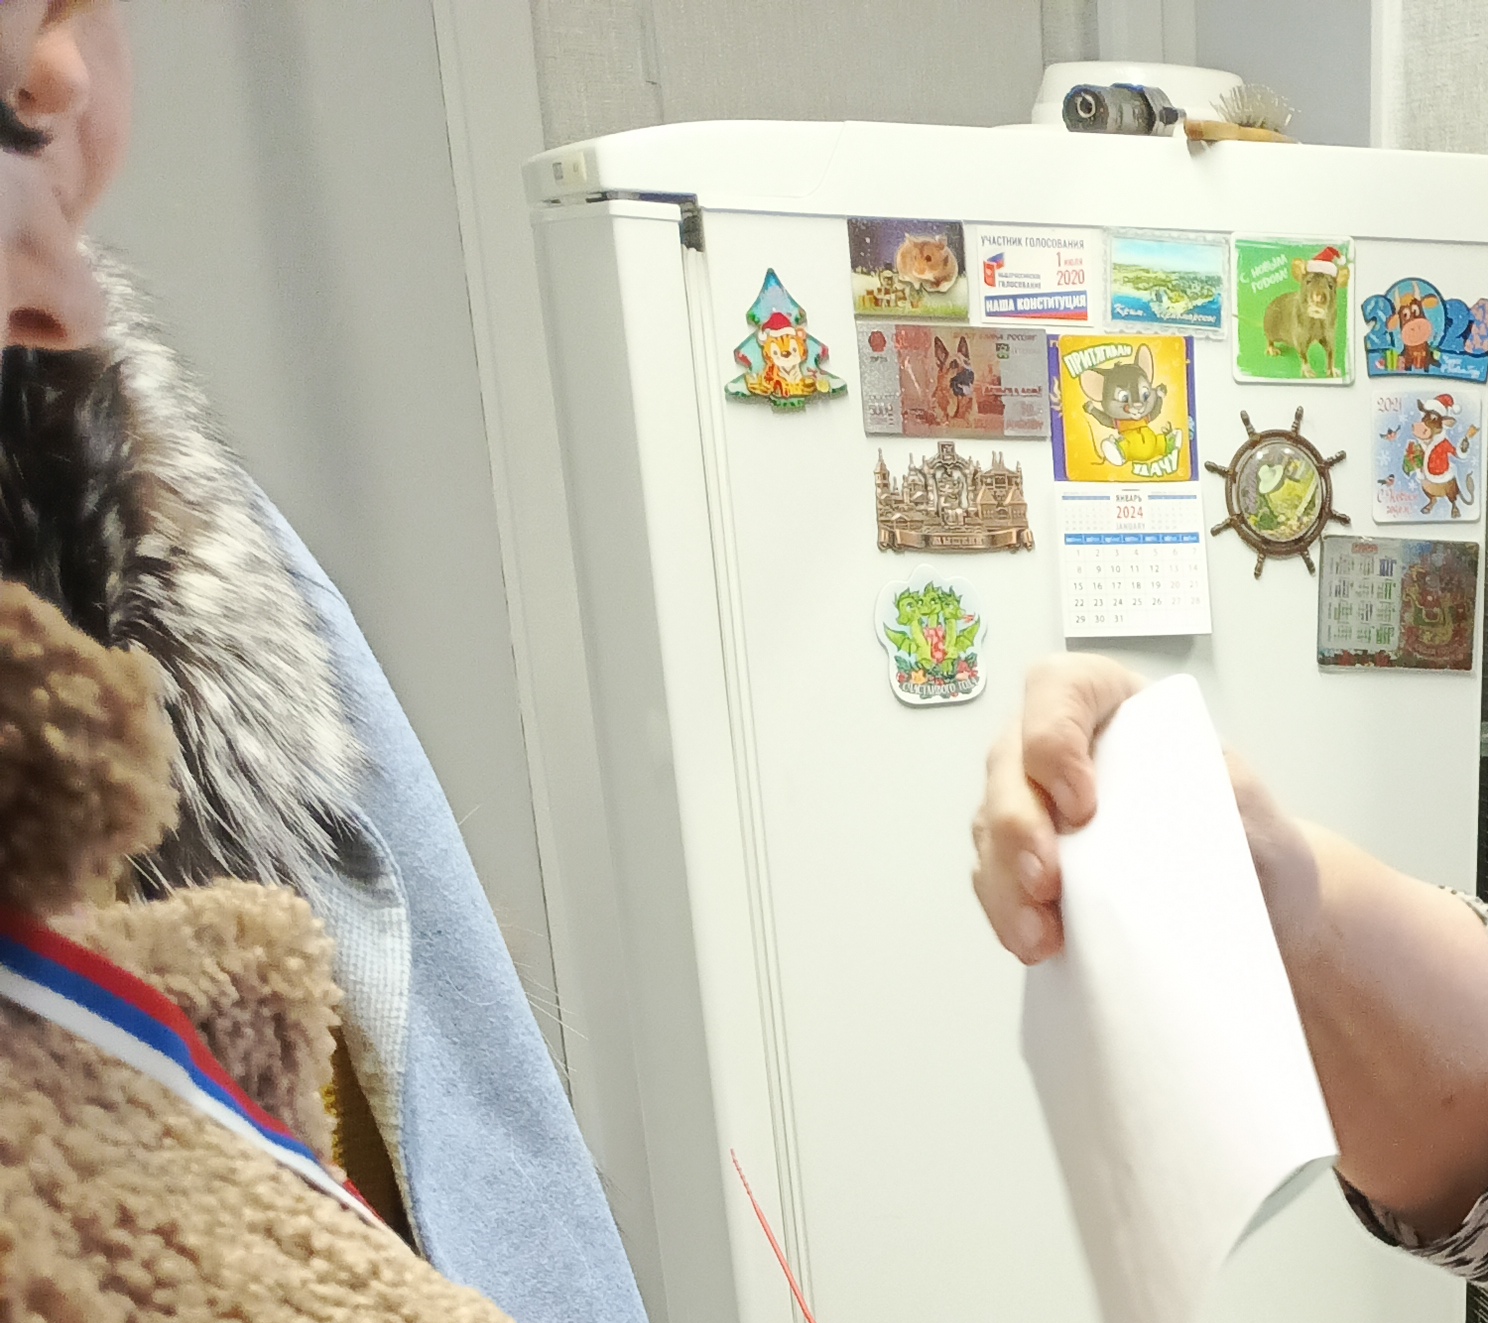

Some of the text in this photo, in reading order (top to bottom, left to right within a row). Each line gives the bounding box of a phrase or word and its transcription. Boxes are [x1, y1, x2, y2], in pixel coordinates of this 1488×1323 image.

[981, 235, 1084, 249] УЧАСТНИК ГОЛОСОВАНИЯ
[1056, 268, 1085, 286] 2020
[985, 295, 1086, 312] НАША КОНСТИТУЦИЯ
[1116, 506, 1144, 519] 2024
[1150, 565, 1160, 573] 12
[1093, 582, 1102, 590] 16
[1074, 599, 1084, 607] 22
[1093, 599, 1104, 607] 23
